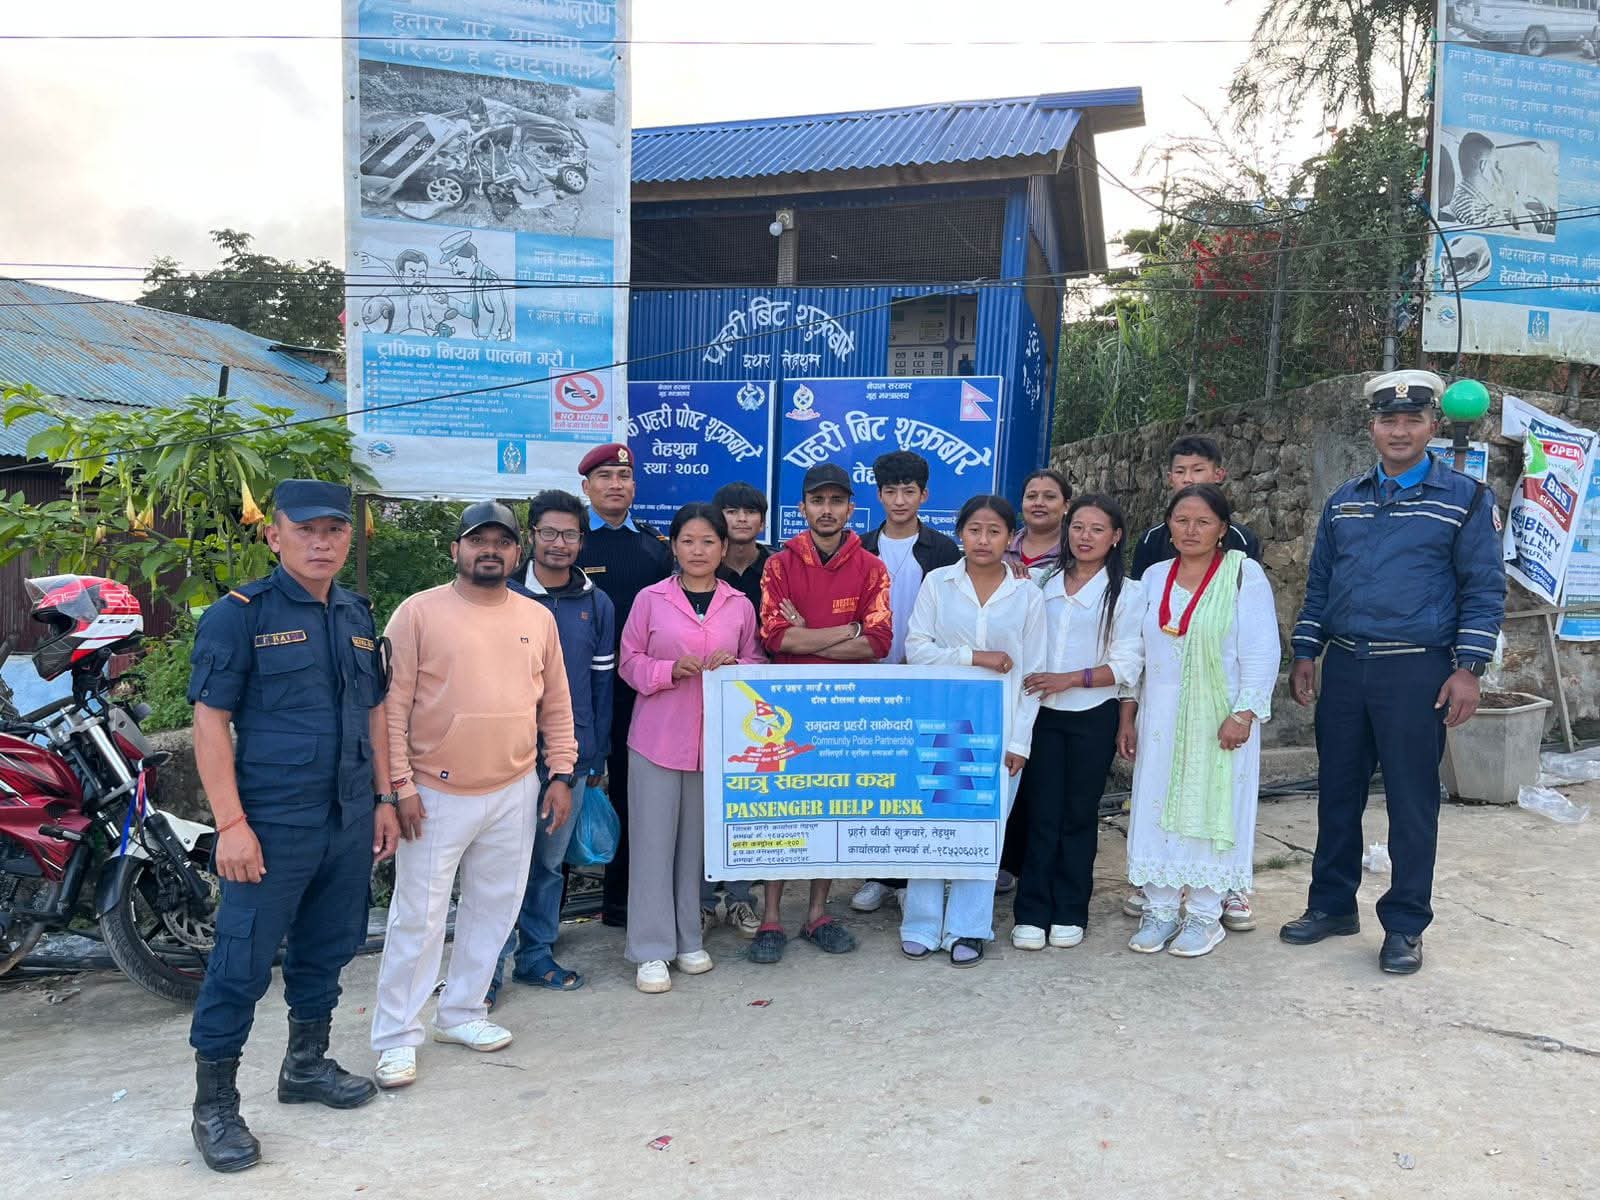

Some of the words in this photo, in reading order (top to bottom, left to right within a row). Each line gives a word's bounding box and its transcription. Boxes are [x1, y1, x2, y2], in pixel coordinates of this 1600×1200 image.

[749, 296, 791, 330] बिट
[377, 340, 432, 359] ट्राफिक
[437, 342, 479, 361] नियम
[486, 348, 532, 364] पालना
[888, 382, 912, 390] सरकार
[637, 403, 673, 434] प्रहरी
[676, 403, 707, 431] पोष्ट
[783, 420, 846, 469] प्रहरी
[845, 411, 889, 444] बिट
[1550, 444, 1580, 459] OPEN
[675, 464, 709, 475] २०८०
[1547, 476, 1569, 507] BBS
[811, 735, 851, 746] Community
[853, 735, 873, 745] Police
[875, 735, 914, 746] Partnership
[774, 774, 851, 790] सहायता
[856, 773, 897, 789] कक्ष
[726, 800, 824, 819] PASSENGER
[829, 799, 874, 815] HELP
[880, 799, 924, 815] DESK
[848, 826, 867, 838] प्रहरी
[870, 825, 891, 837] चौकी
[894, 843, 919, 855] सम्पर्क
